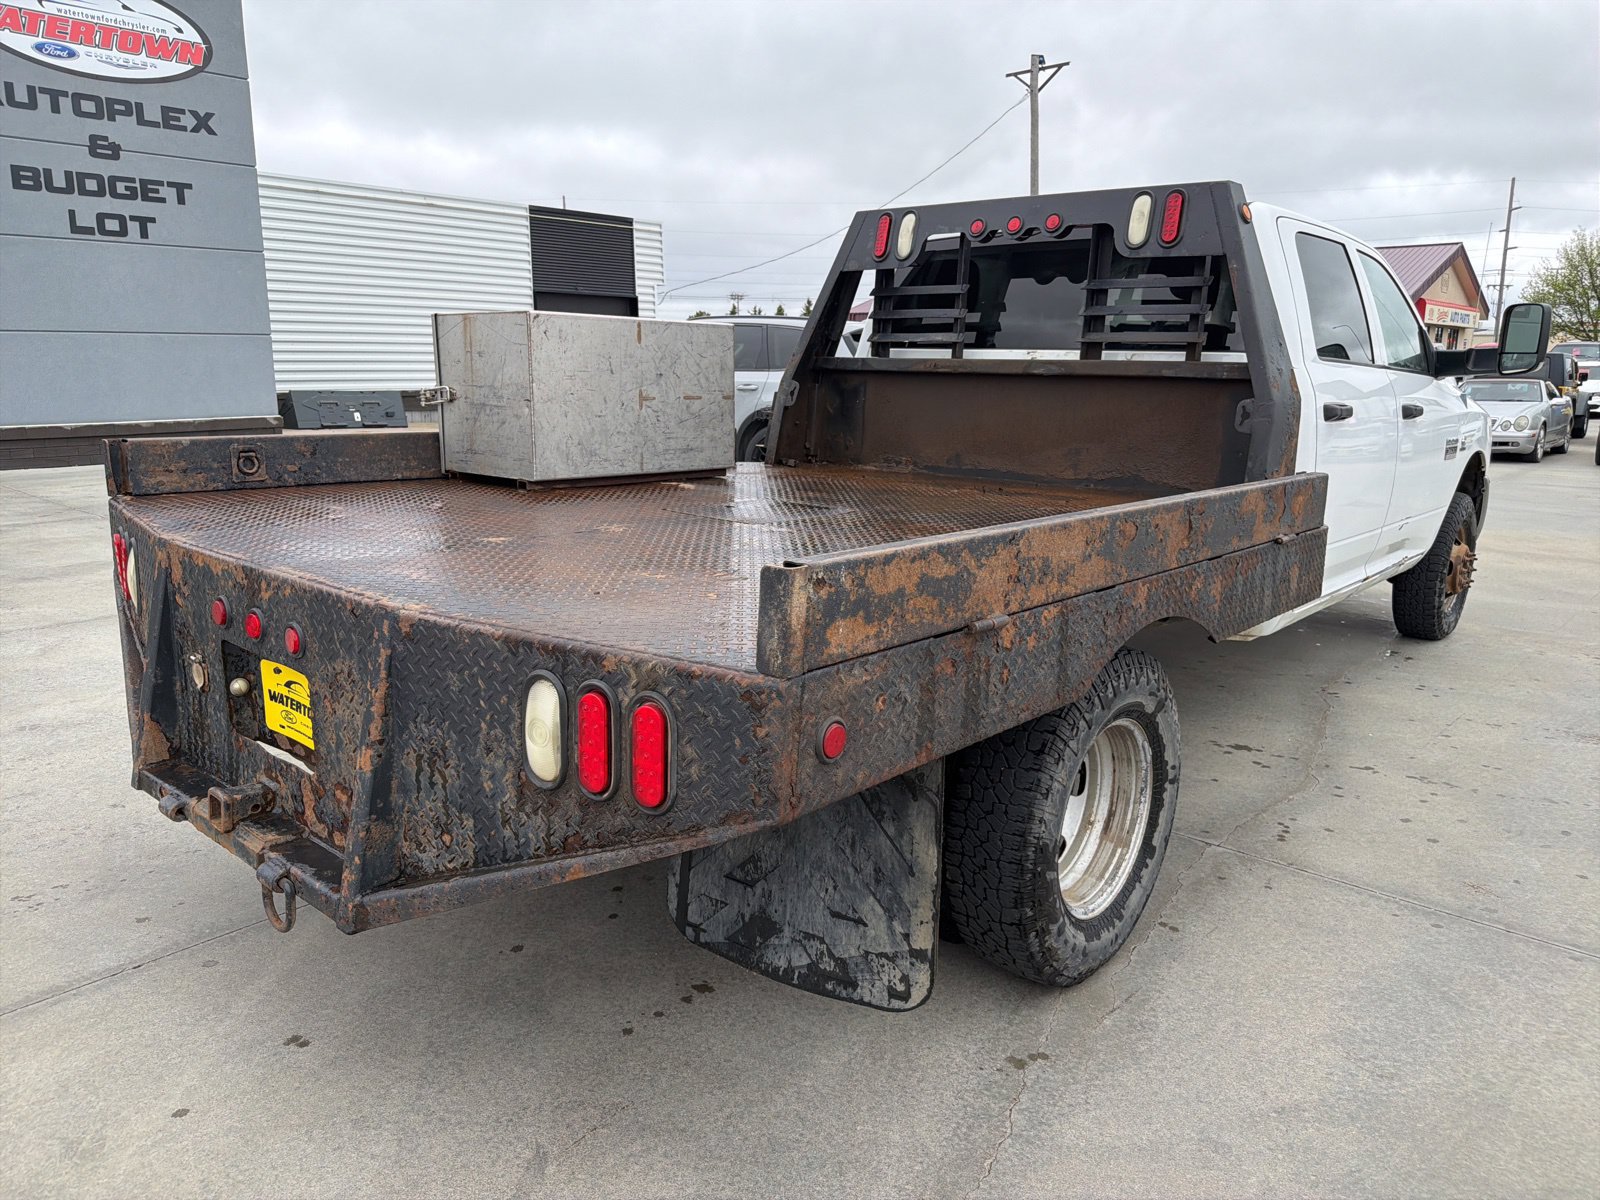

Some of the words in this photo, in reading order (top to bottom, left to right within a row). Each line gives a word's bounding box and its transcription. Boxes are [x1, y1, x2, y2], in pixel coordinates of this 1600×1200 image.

[0, 5, 204, 66] ATERTOWN
[57, 7, 167, 35] watertownfordchrysler.com
[42, 43, 69, 58] Ford
[84, 50, 158, 69] CHRYSLER
[0, 81, 218, 136] UTOPLEX
[88, 134, 122, 161] &
[10, 164, 193, 206] BUDGET
[68, 209, 157, 239] LOT
